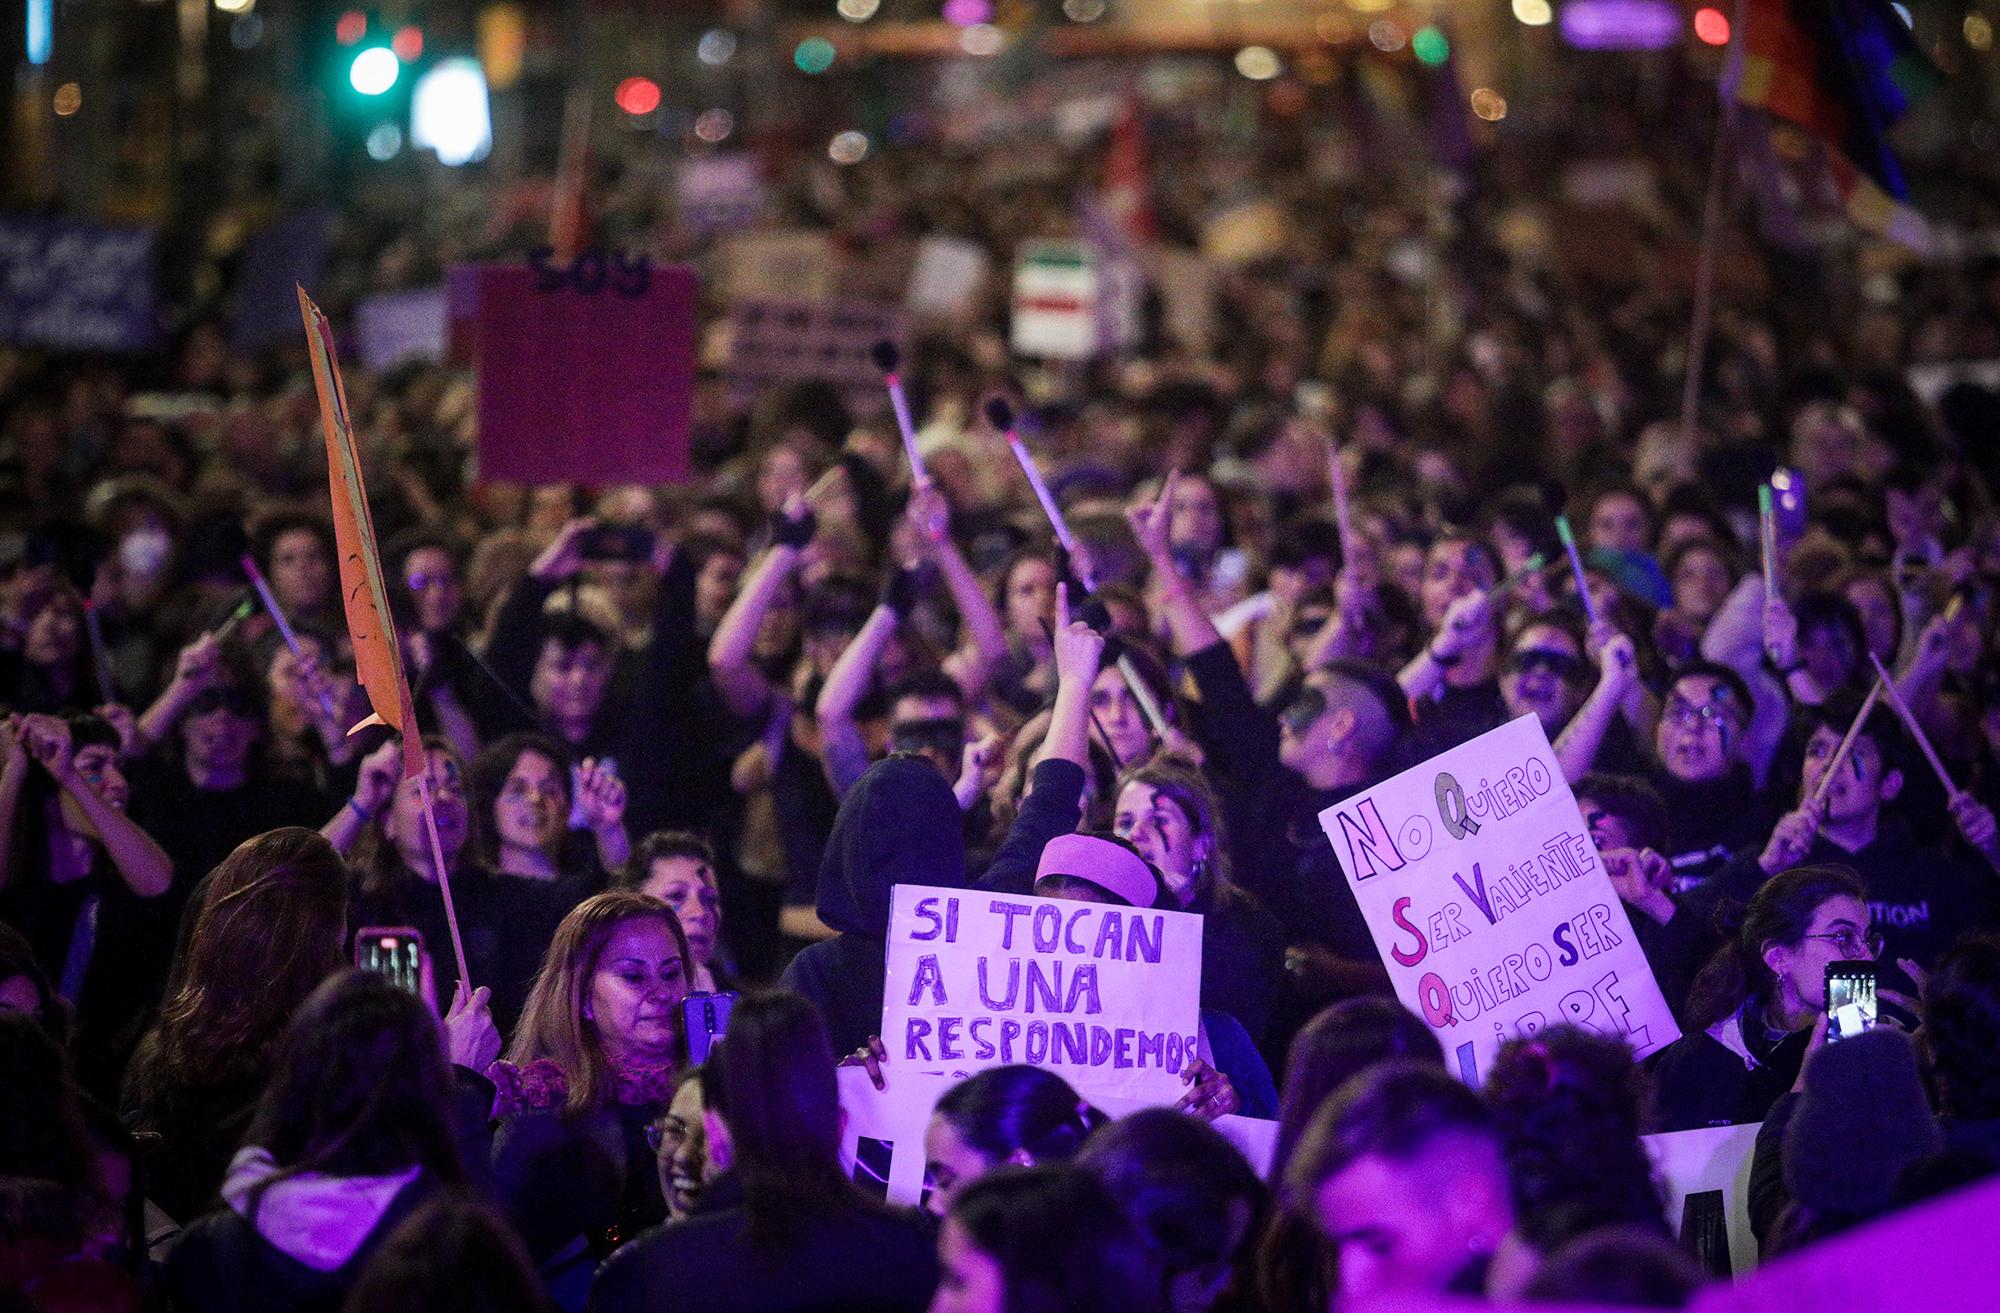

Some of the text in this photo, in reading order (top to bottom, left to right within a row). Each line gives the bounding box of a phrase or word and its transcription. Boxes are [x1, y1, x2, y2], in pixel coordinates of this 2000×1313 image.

[909, 897, 1164, 964] SI TOCAN
[906, 953, 1102, 1014] A UNA
[904, 1016, 1197, 1075] RESPONDEMOS
